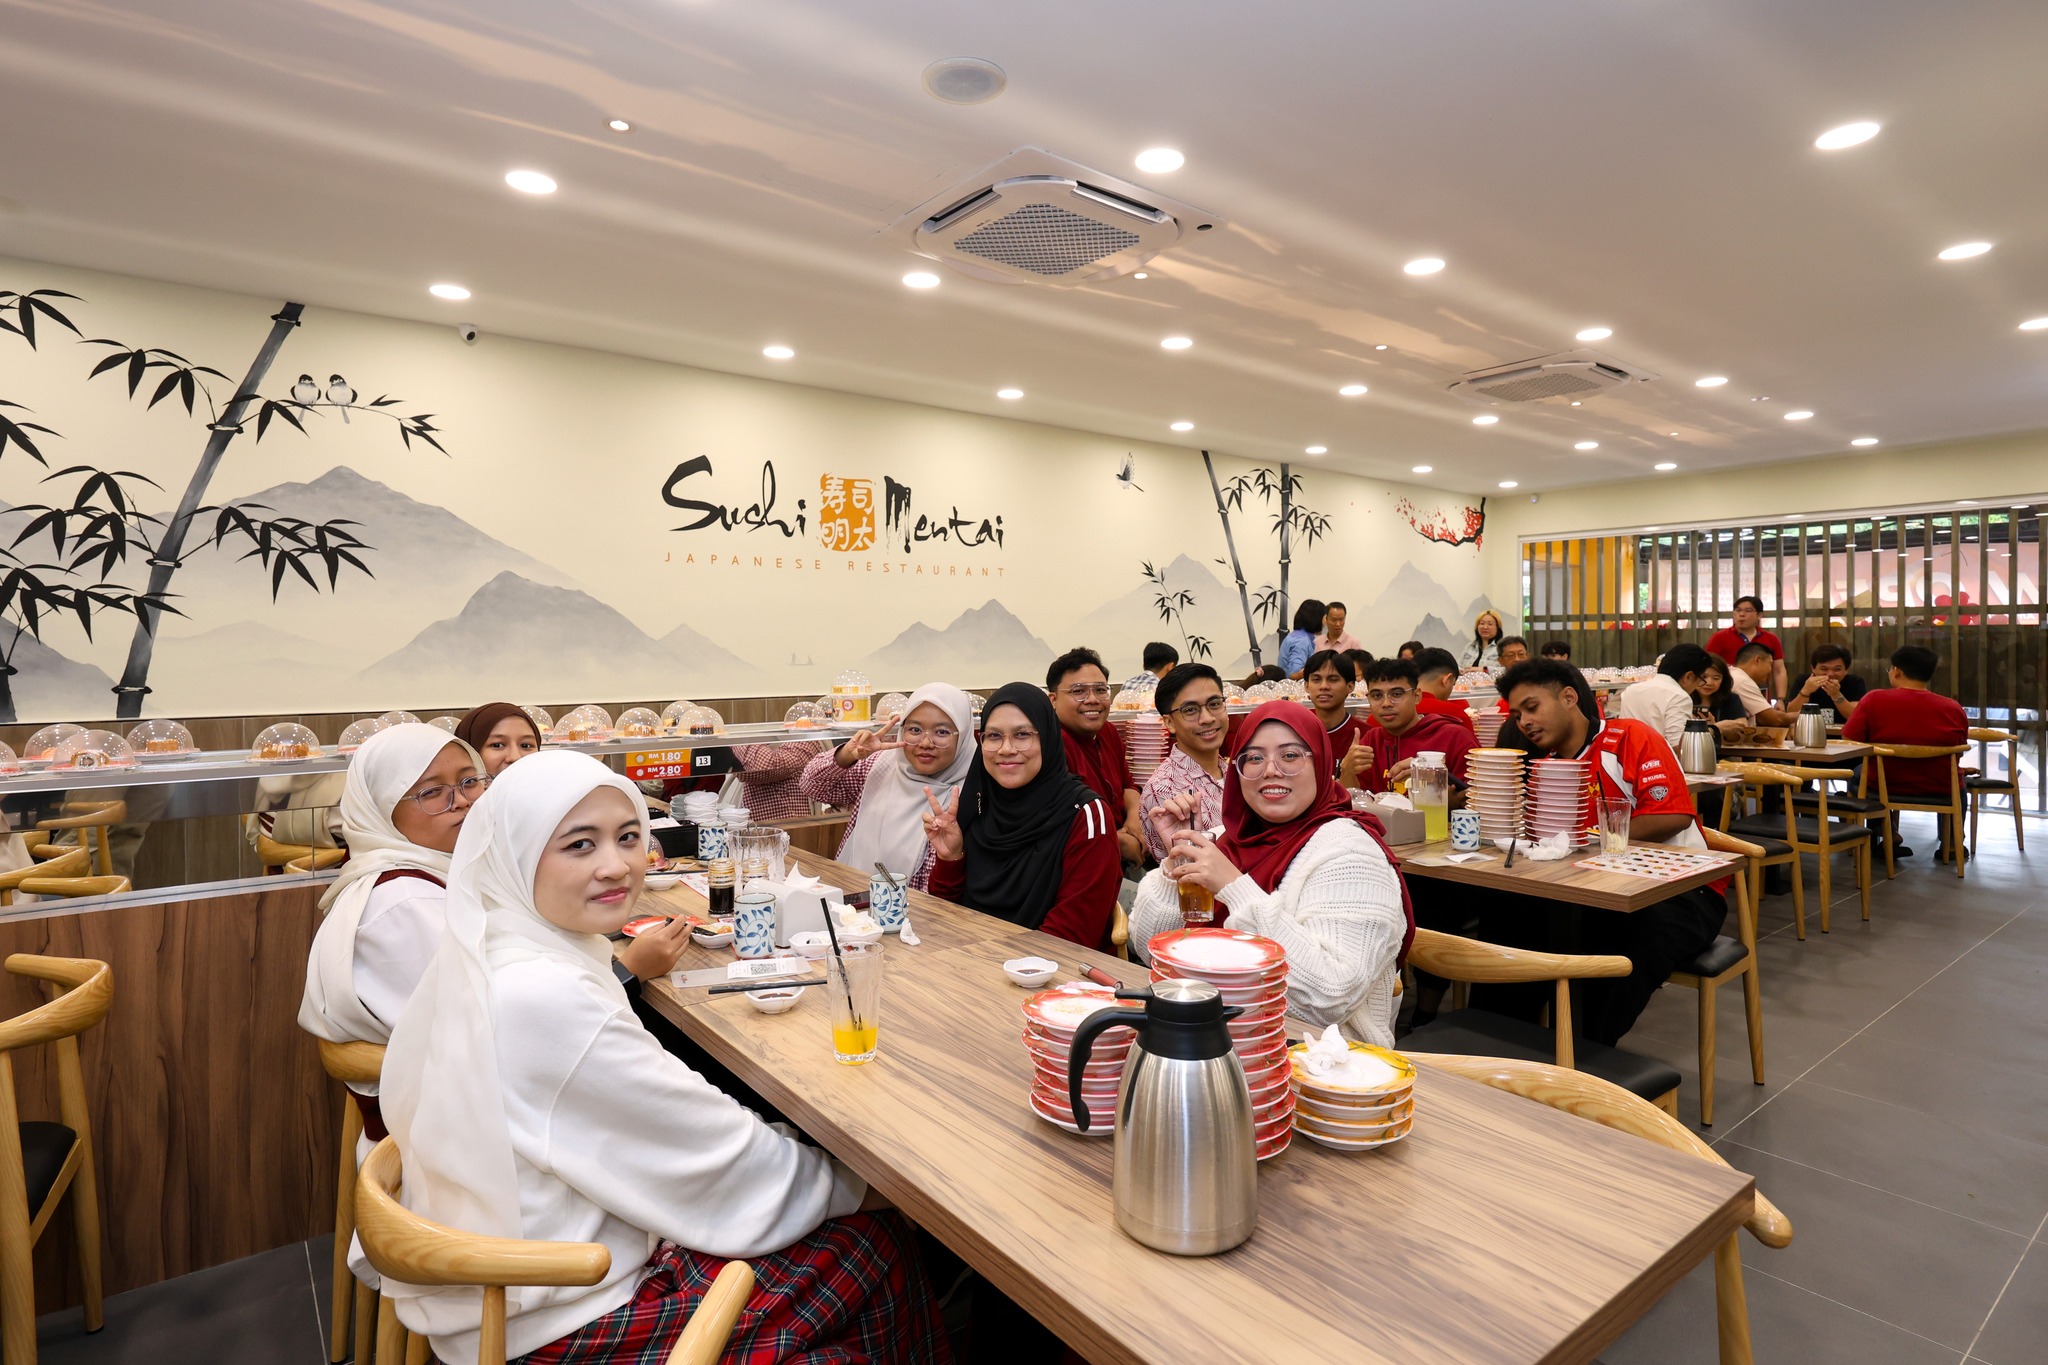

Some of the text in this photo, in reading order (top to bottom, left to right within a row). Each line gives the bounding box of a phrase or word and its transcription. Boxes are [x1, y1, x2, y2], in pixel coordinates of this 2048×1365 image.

[662, 455, 1003, 554] Sushi Mentai
[665, 552, 1005, 578] JAPANESE RESTAURANT
[661, 752, 680, 760] 1.80
[698, 757, 708, 765] 13
[659, 766, 680, 775] 2.80
